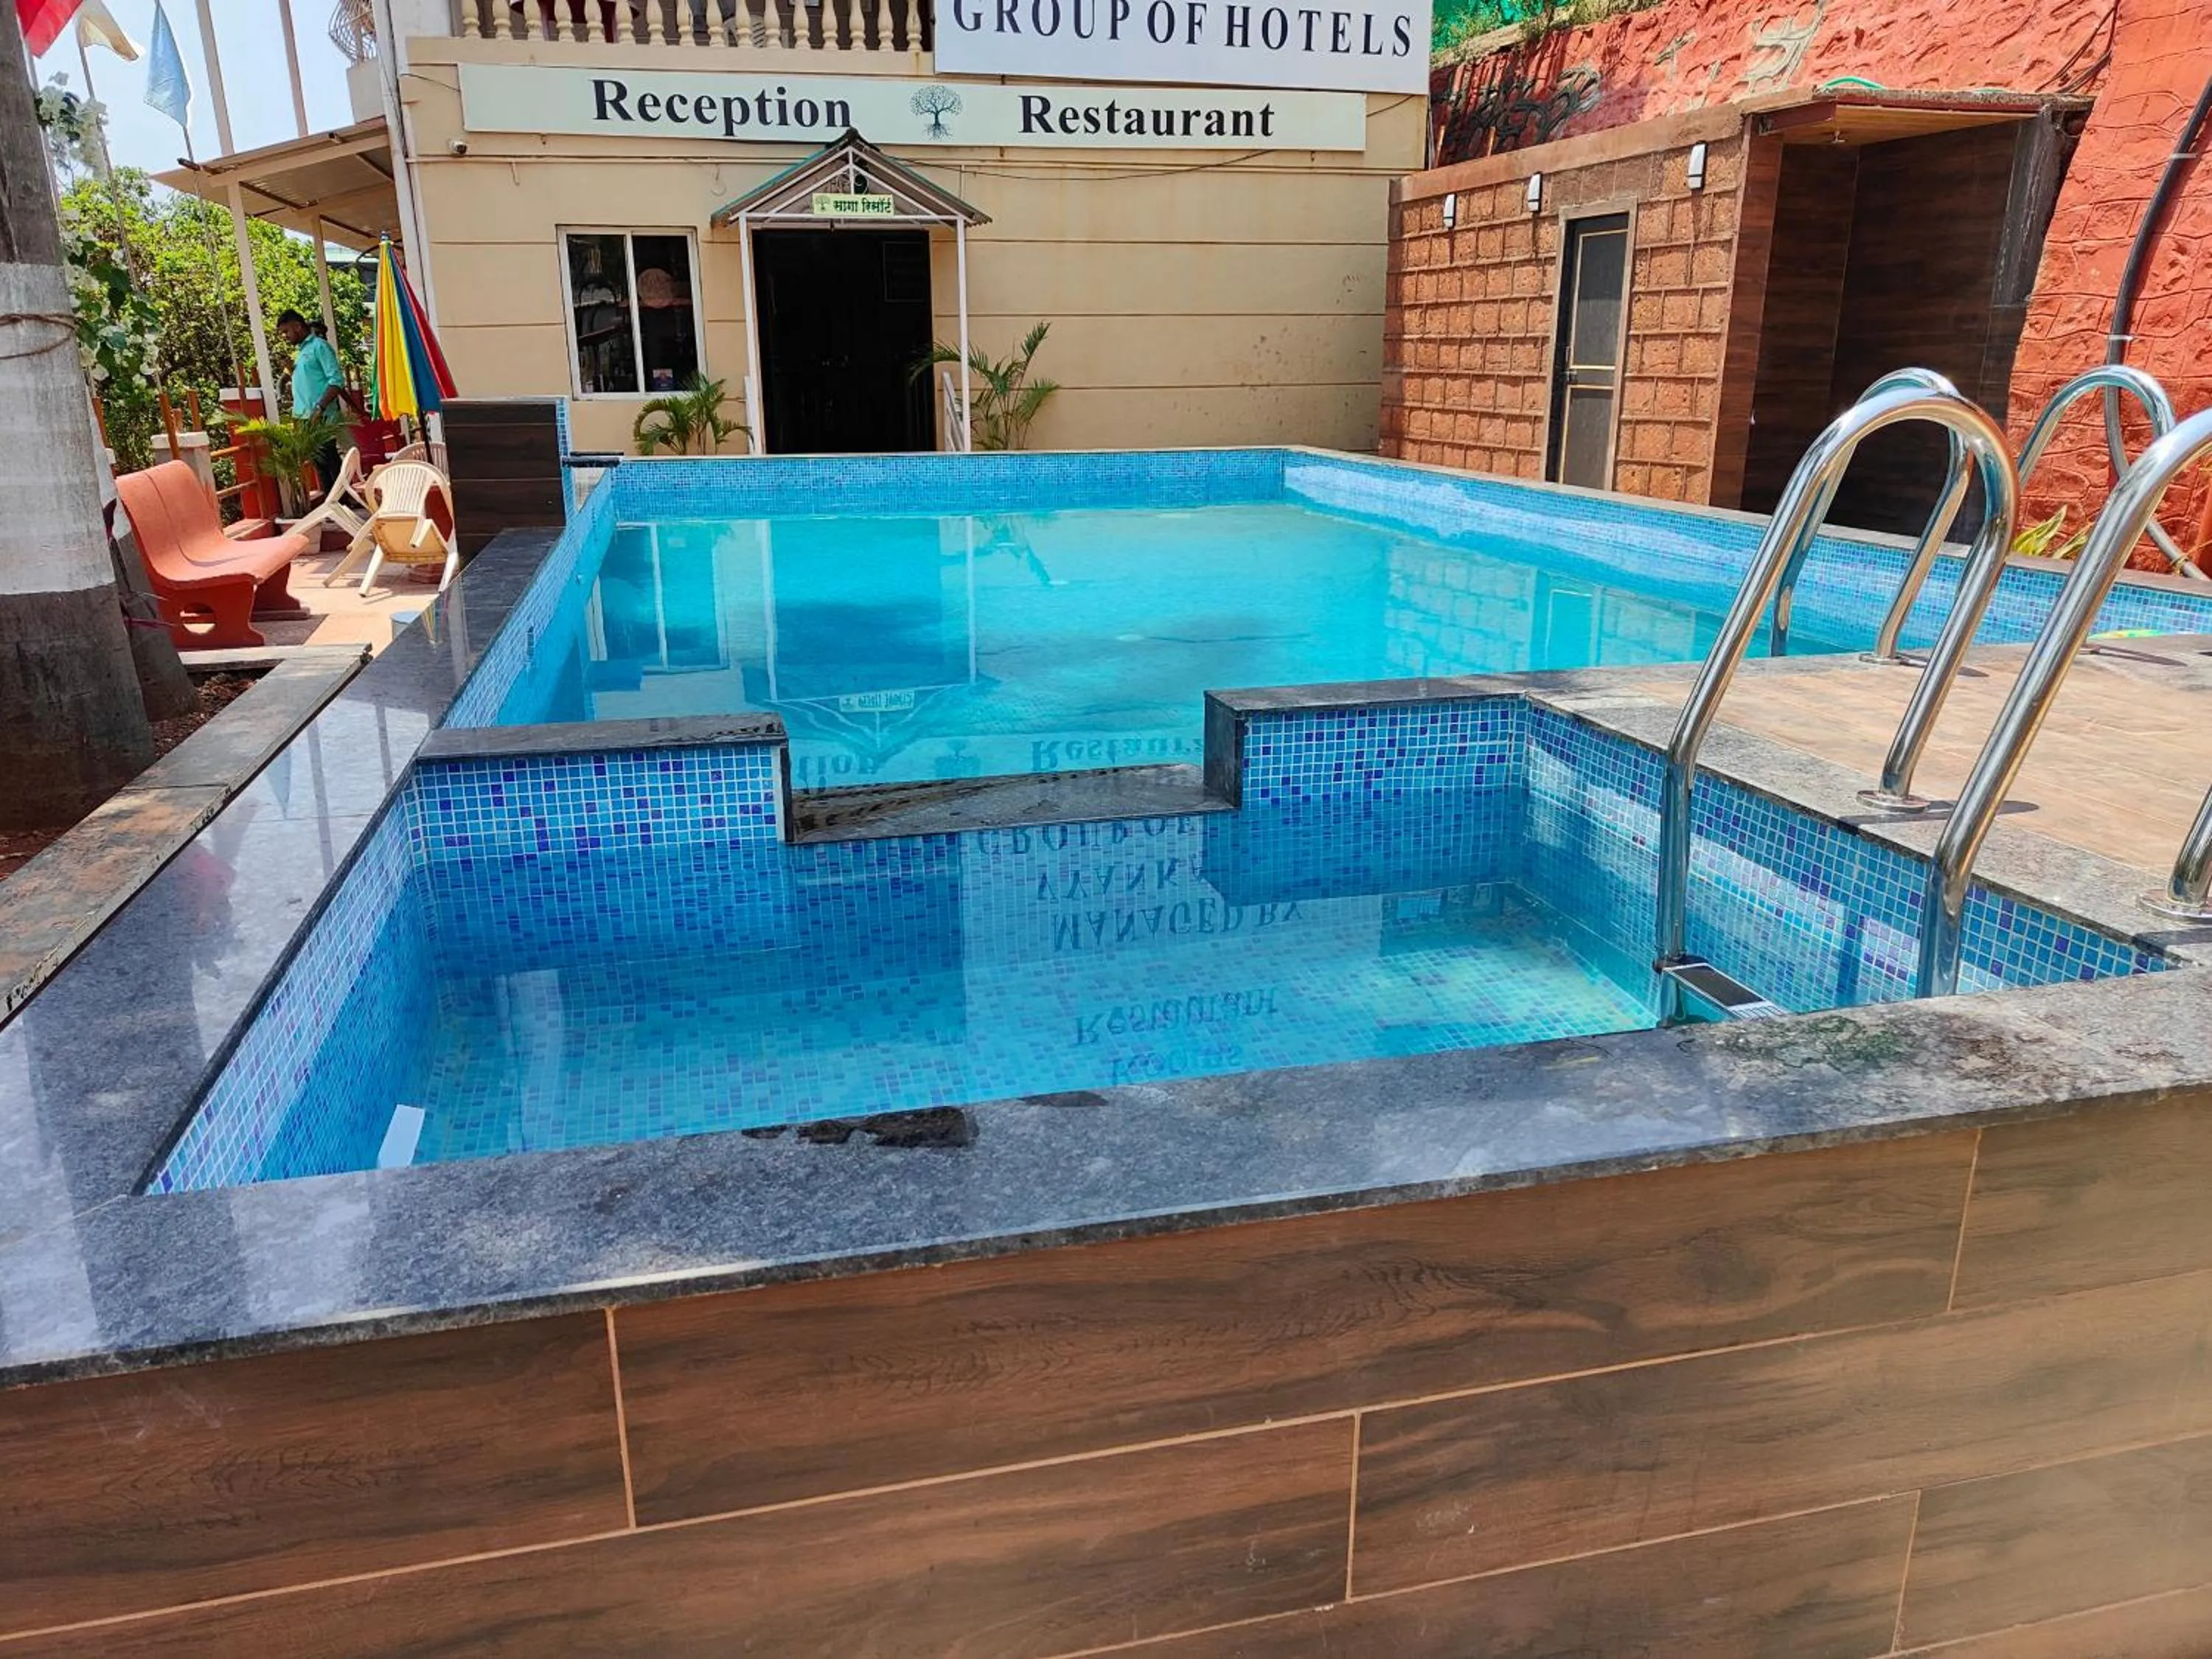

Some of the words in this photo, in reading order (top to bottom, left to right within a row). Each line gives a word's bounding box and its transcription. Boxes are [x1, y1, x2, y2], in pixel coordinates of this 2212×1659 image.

[953, 0, 1130, 39] GROUP
[1147, 1, 1207, 44] OF
[1225, 6, 1411, 57] HOTELS
[592, 79, 852, 136] Reception
[1018, 94, 1275, 138] Restaurant
